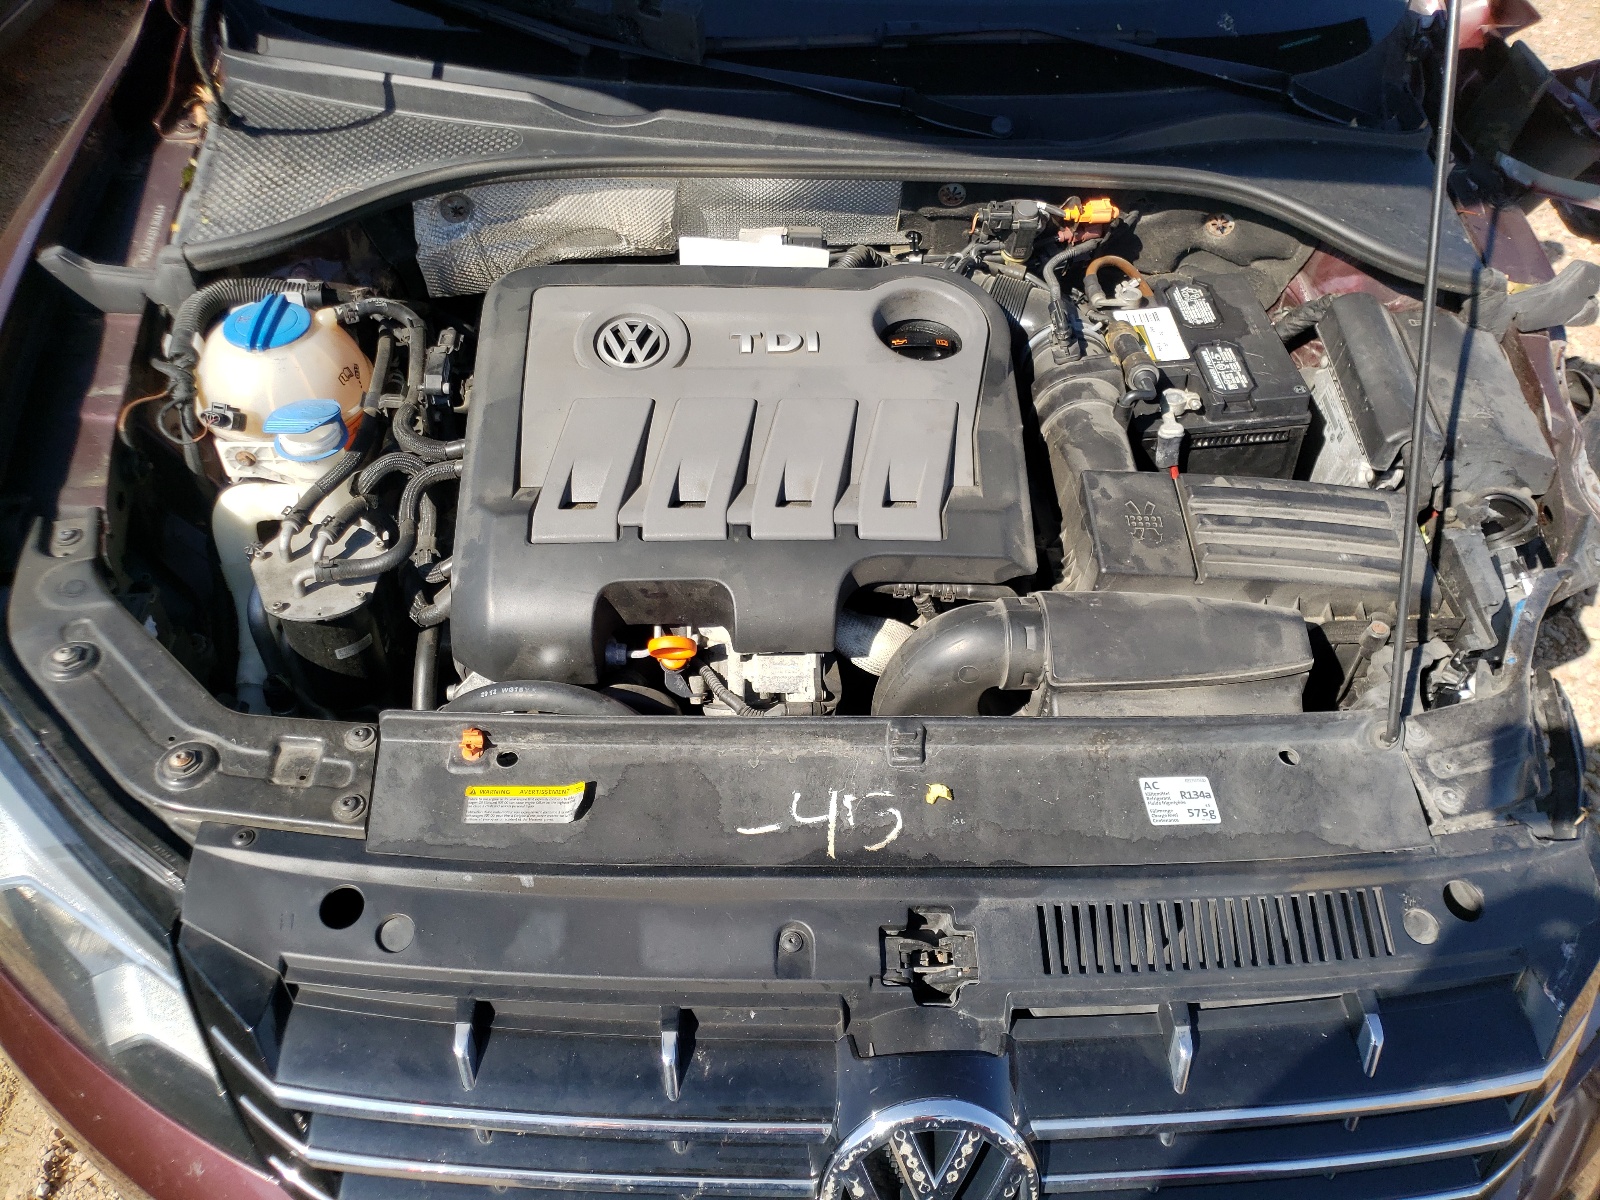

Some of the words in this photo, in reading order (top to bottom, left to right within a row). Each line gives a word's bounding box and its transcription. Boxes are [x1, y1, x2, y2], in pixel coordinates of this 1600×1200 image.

[729, 330, 820, 354] TDI
[1144, 781, 1160, 790] AC
[1180, 790, 1212, 799] R134a
[1187, 809, 1216, 820] 575g
